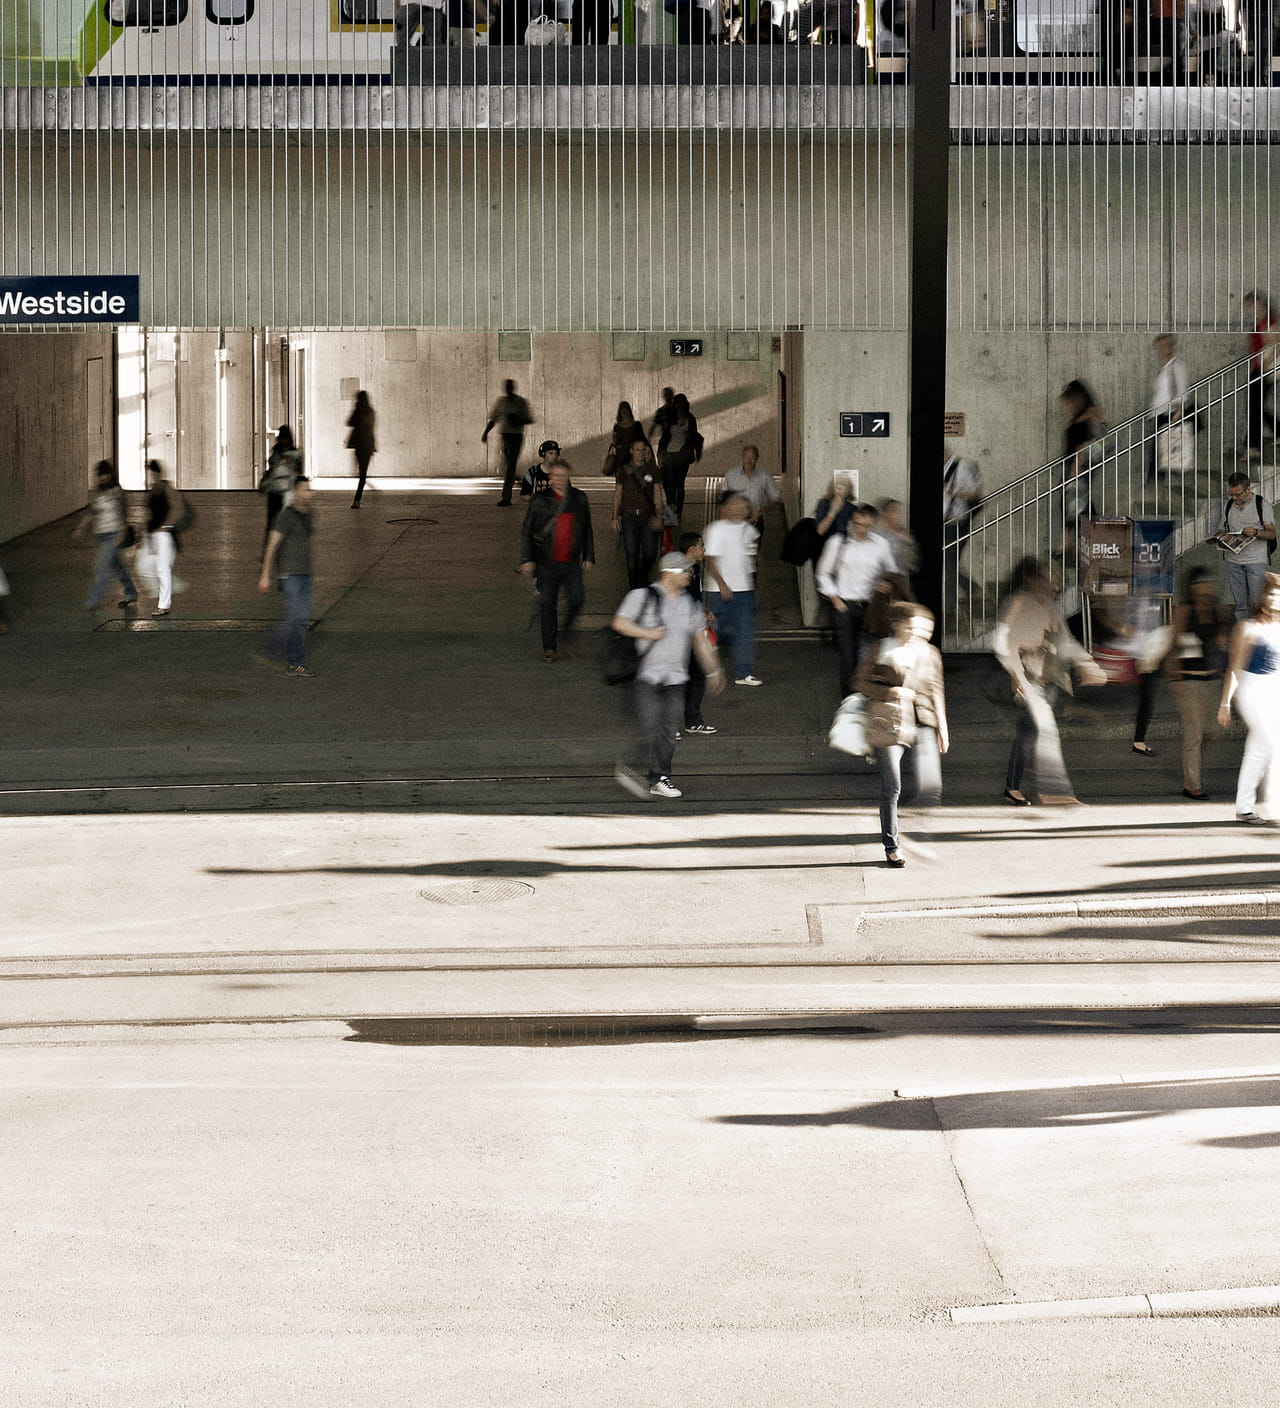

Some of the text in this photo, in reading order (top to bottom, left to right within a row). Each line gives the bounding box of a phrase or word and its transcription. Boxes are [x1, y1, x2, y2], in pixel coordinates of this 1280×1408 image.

[675, 344, 682, 354] 2
[848, 422, 854, 433] 1
[1092, 543, 1120, 555] Blick
[1139, 543, 1160, 562] 20
